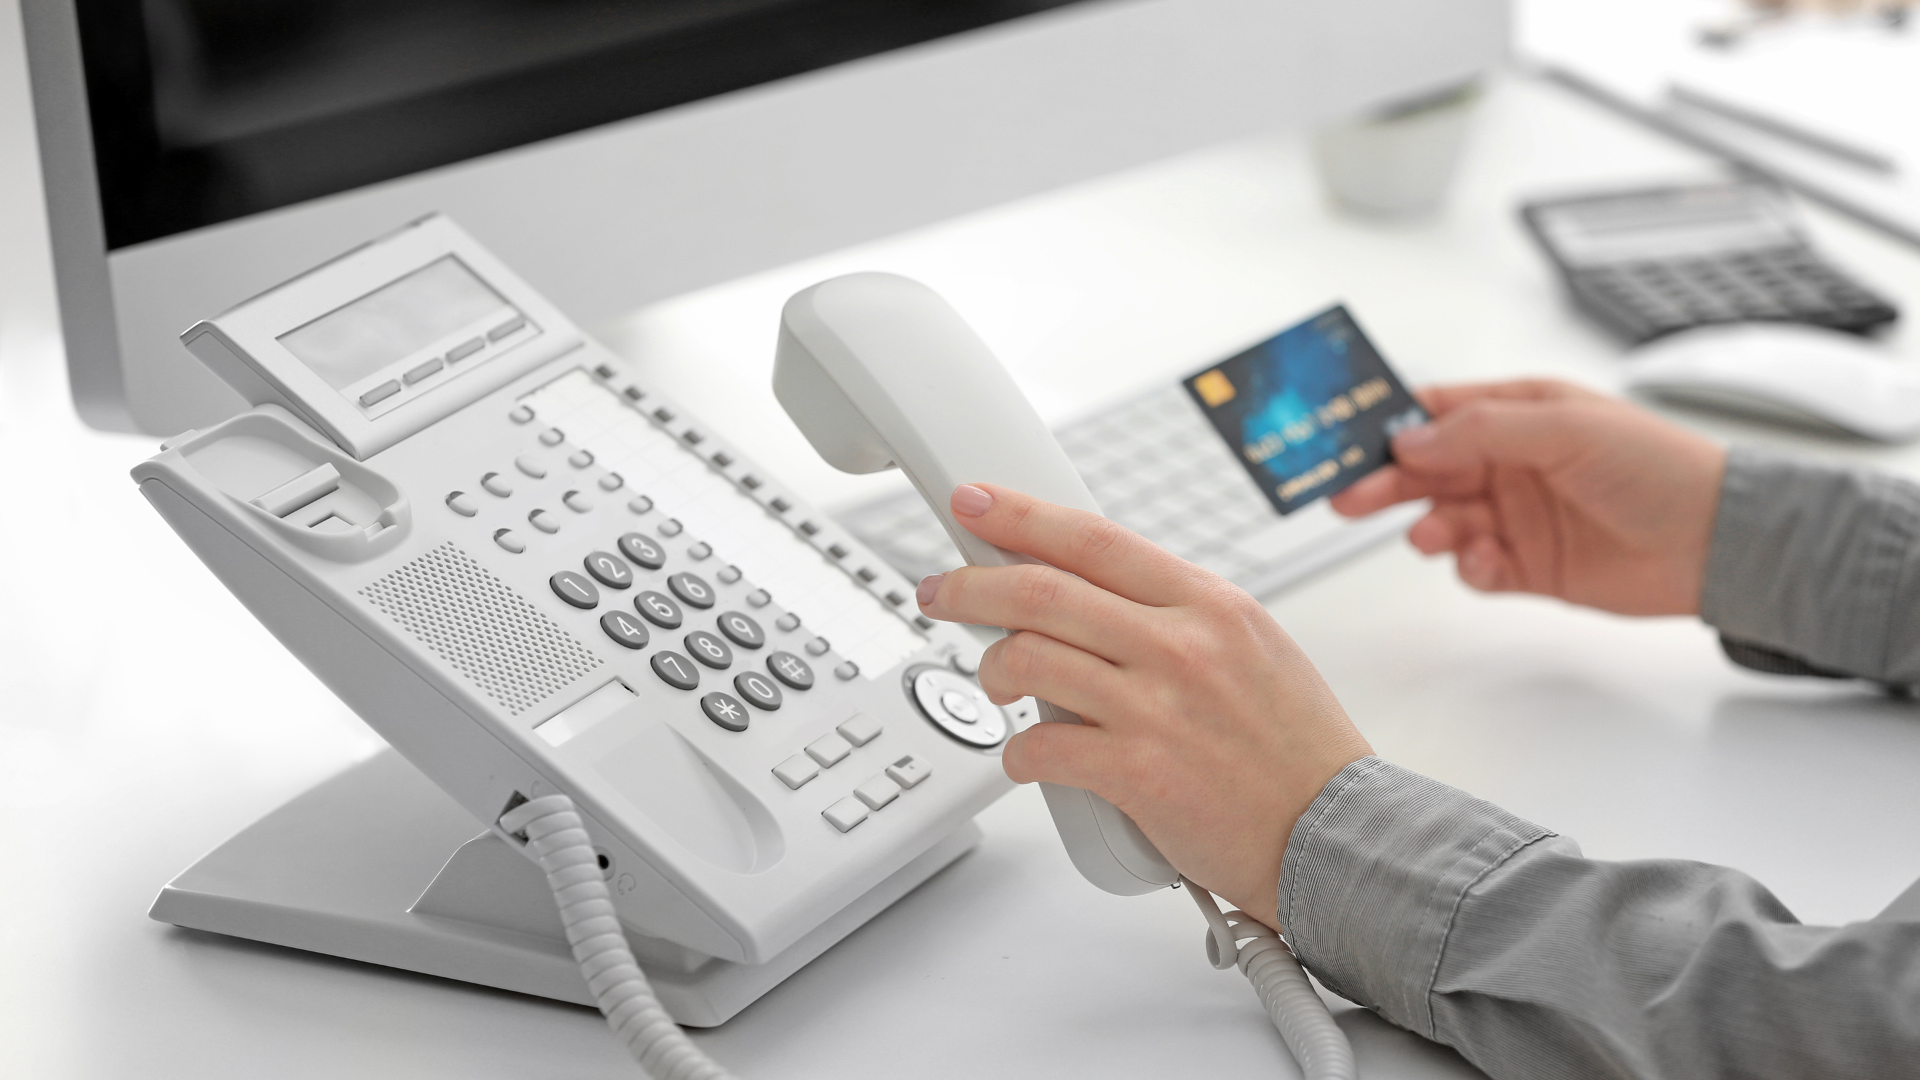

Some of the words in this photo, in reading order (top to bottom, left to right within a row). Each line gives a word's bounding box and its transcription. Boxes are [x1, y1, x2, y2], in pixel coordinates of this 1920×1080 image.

[563, 577, 589, 597] 1
[598, 557, 626, 579] 2
[631, 537, 657, 558] 3
[616, 616, 641, 637] 4
[647, 596, 673, 617] 5
[682, 577, 706, 598] 6
[663, 656, 687, 679] 7
[698, 637, 724, 658] 8
[730, 616, 755, 638] 9
[747, 677, 773, 699] 0
[780, 656, 805, 680] #
